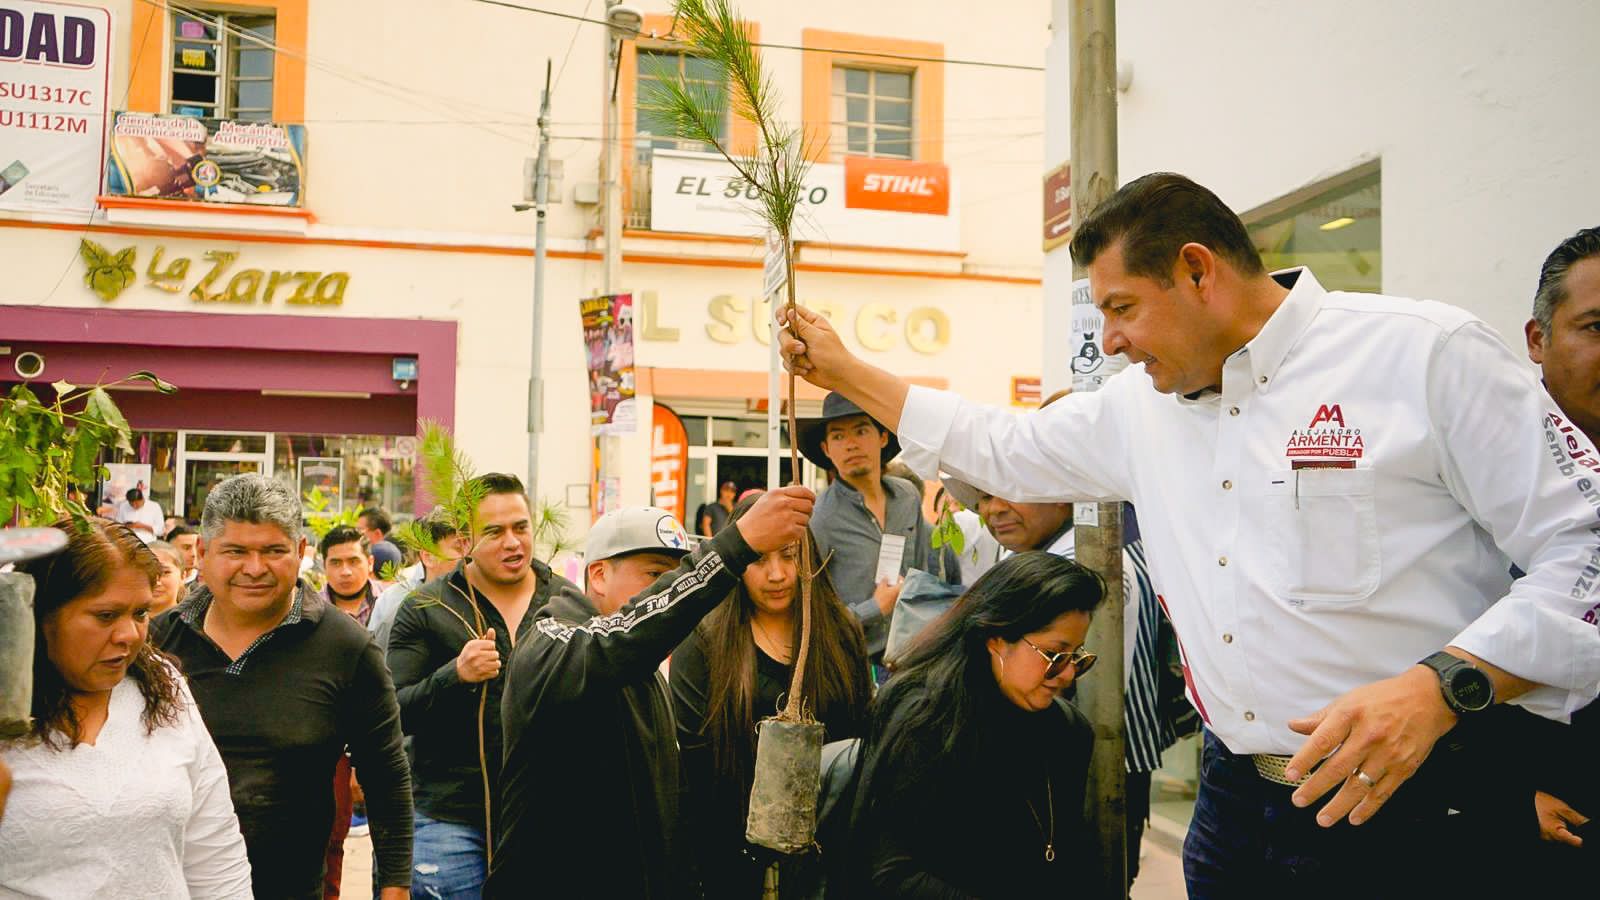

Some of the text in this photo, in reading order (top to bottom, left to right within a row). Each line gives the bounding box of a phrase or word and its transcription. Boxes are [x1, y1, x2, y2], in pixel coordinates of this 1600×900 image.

[0, 82, 92, 106] SU1317C
[117, 115, 199, 131] Ciencias de la
[214, 132, 289, 148] Automotriz
[675, 176, 712, 197] EL
[146, 245, 351, 306] La Zarza
[1287, 435, 1364, 448] ARMENTA
[1322, 448, 1359, 457] PUEBLA
